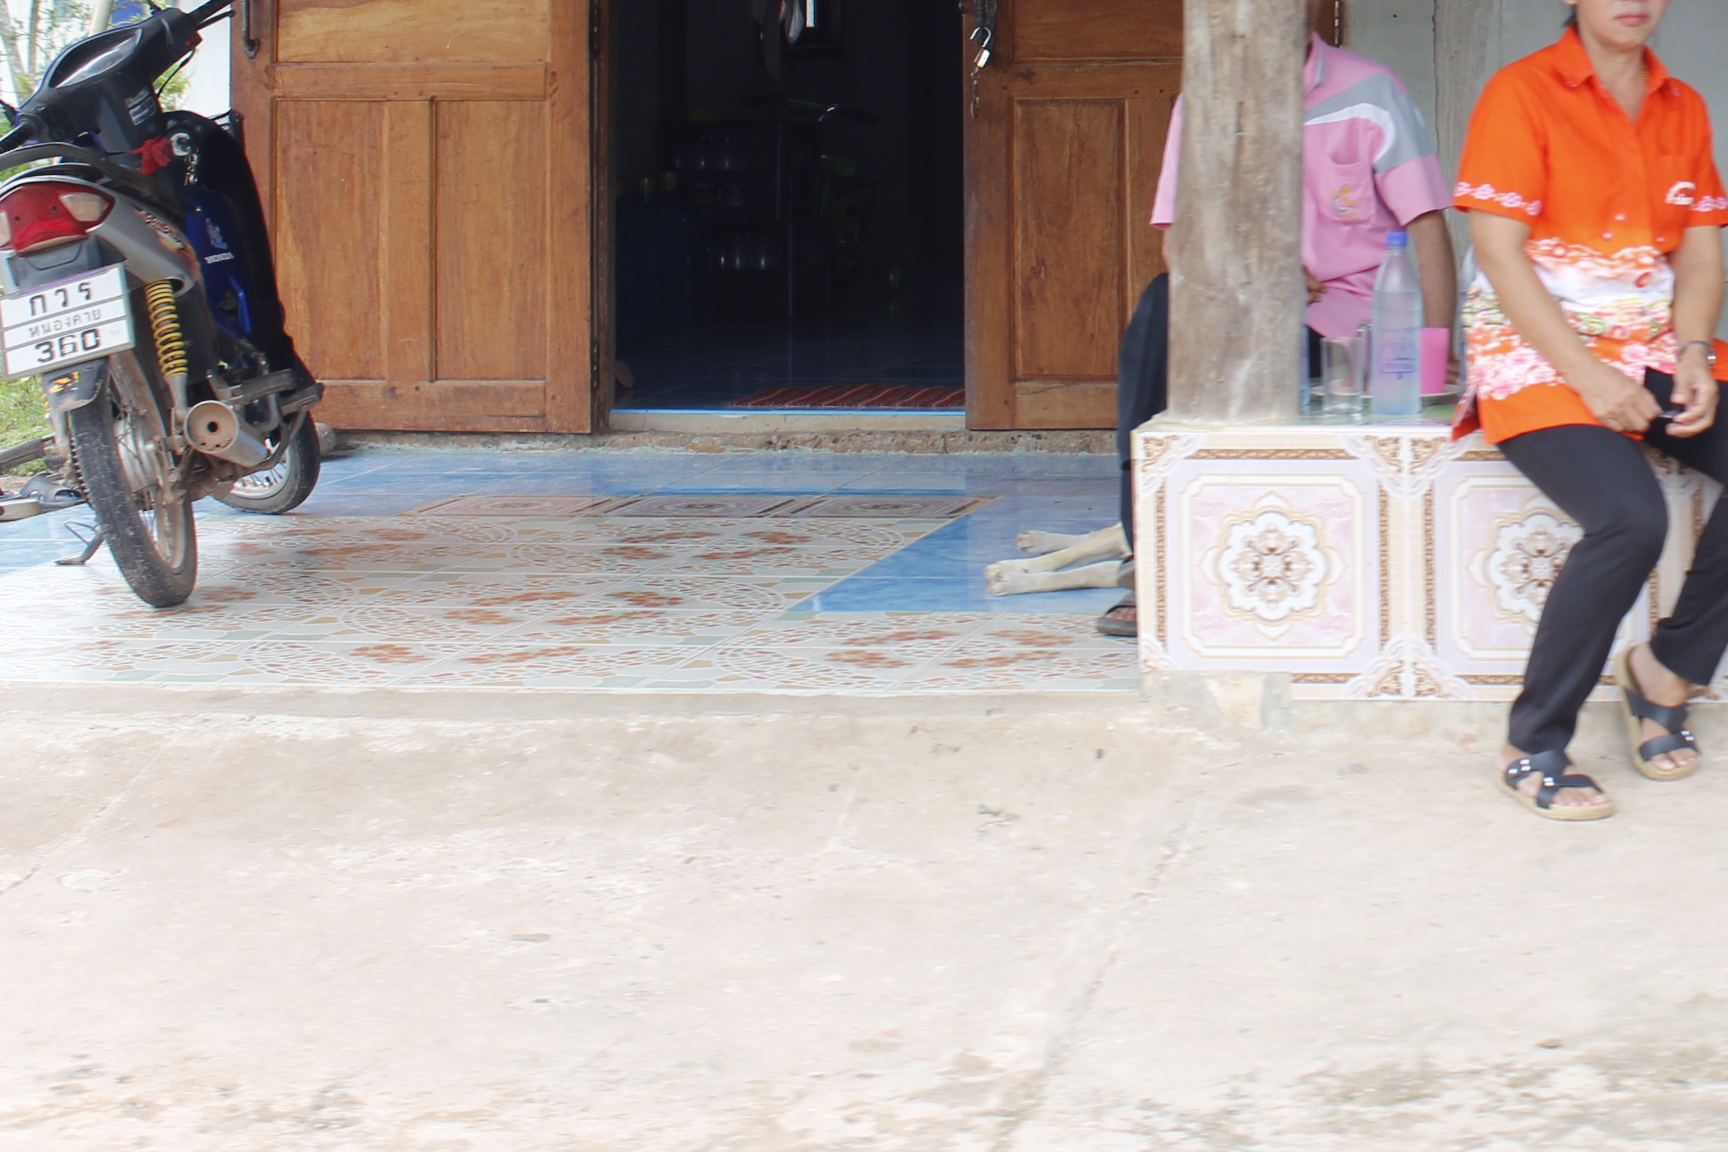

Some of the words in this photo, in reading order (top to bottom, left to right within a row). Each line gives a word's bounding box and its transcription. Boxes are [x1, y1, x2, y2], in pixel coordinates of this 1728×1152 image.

[29, 282, 92, 316] กวร
[28, 309, 102, 338] หนองคาย
[35, 329, 100, 363] 360
